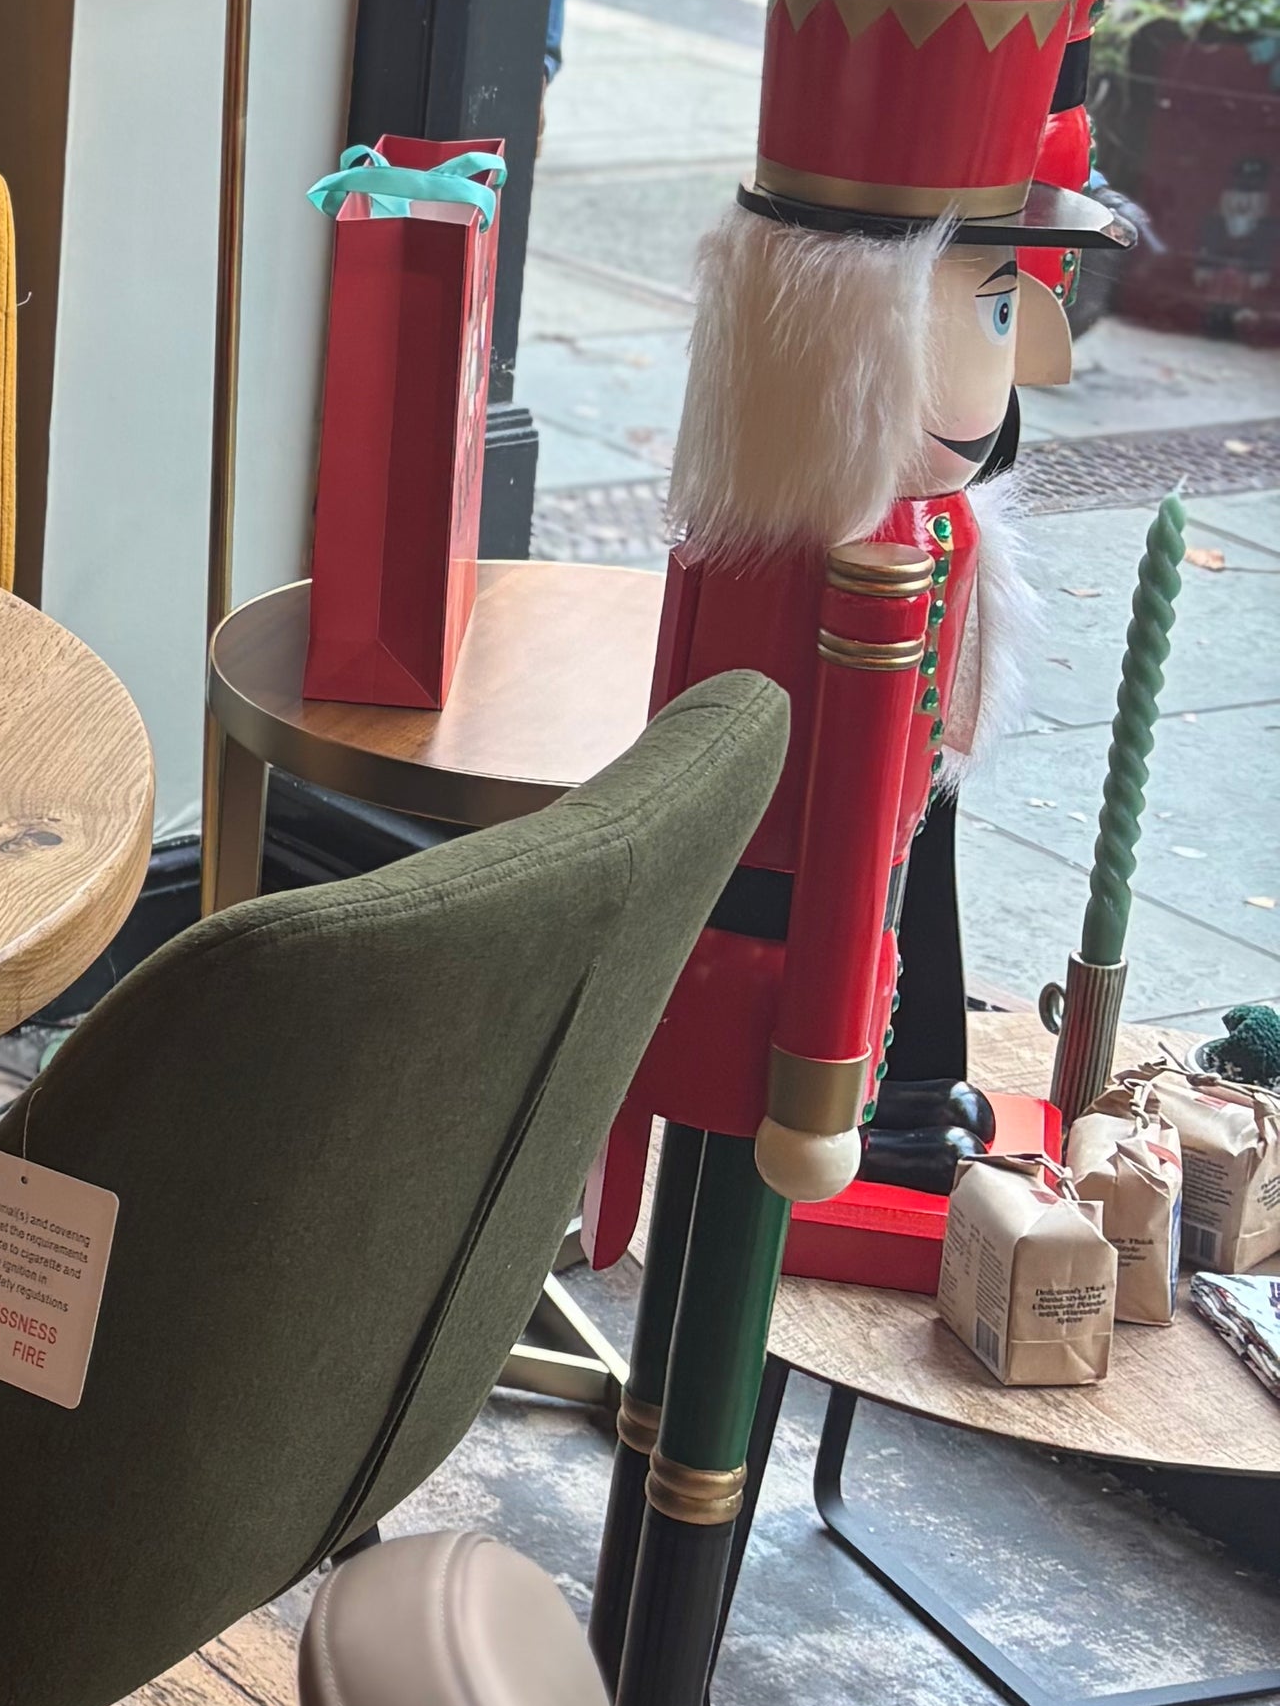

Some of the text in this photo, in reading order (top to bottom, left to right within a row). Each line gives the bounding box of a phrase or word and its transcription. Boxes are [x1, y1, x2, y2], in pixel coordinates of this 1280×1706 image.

[10, 1225, 24, 1239] the
[26, 1233, 88, 1263] requirements
[30, 1215, 48, 1229] and
[50, 1223, 90, 1248] covering
[2, 1259, 37, 1279] ignition
[38, 1272, 48, 1284] in
[10, 1243, 18, 1255] to
[20, 1249, 61, 1272] cigarette
[63, 1264, 81, 1279] and
[16, 1284, 69, 1312] regulations
[13, 1341, 47, 1369] FIRE
